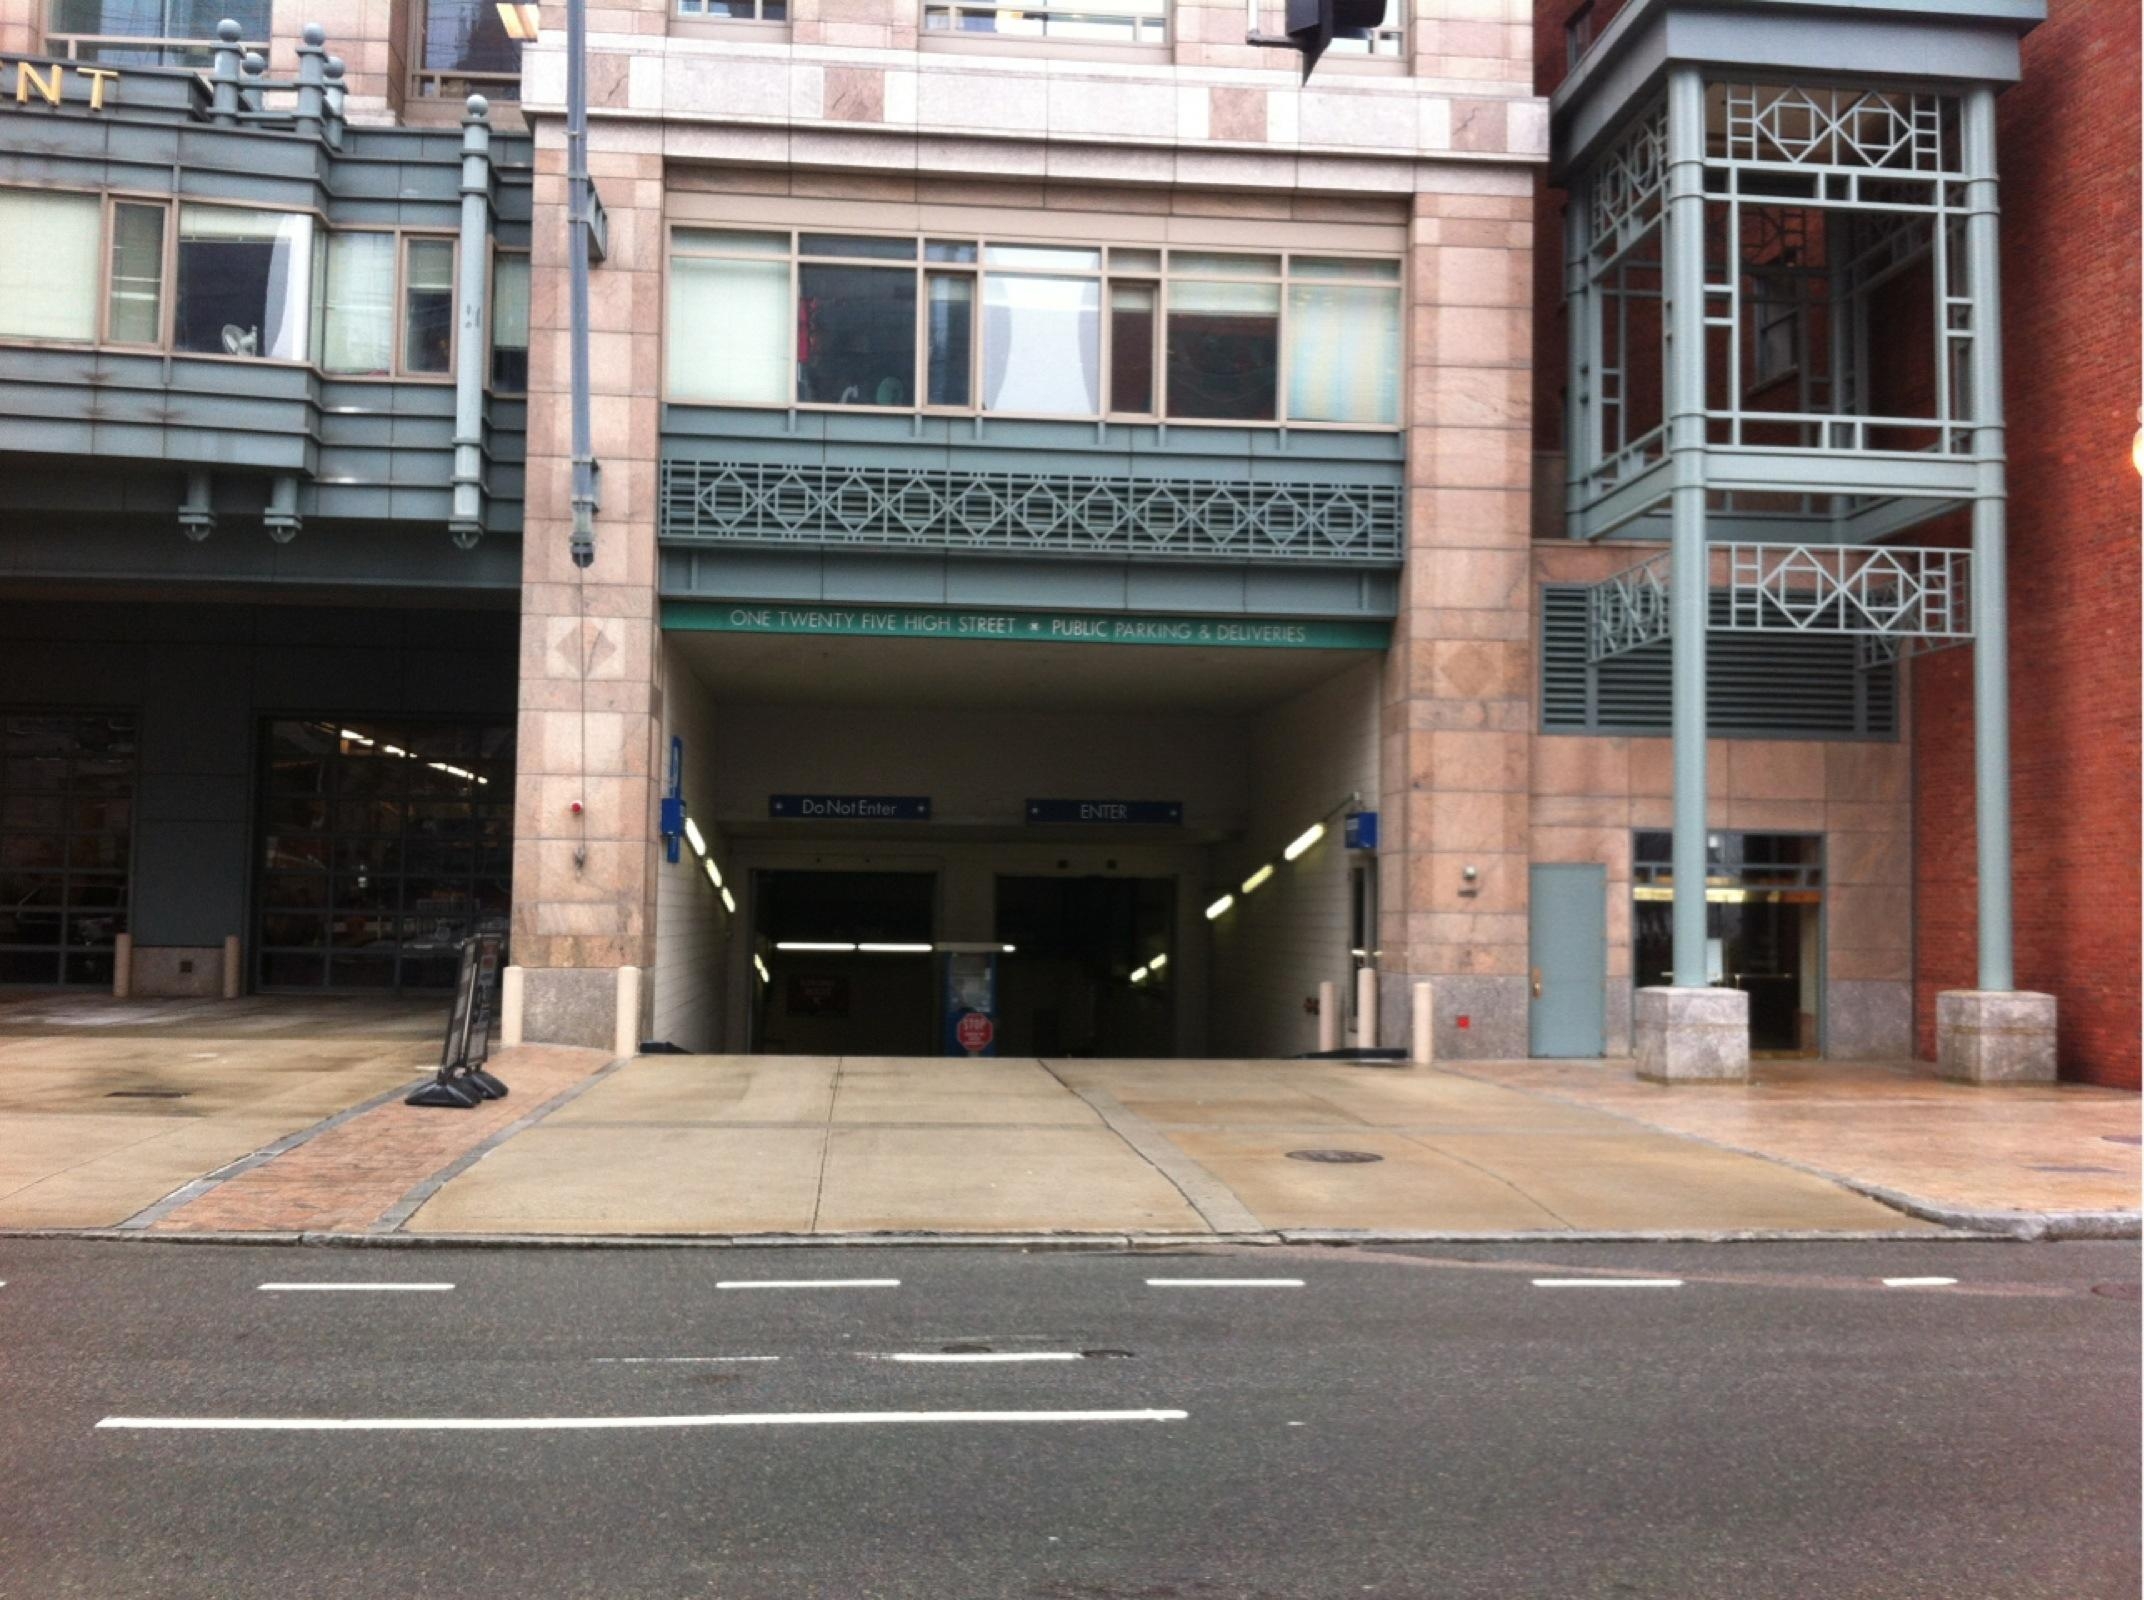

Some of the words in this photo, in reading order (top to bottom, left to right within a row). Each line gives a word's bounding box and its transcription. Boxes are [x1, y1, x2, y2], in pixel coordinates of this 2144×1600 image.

[0, 62, 118, 110] NT
[730, 609, 770, 626] ONE
[778, 611, 852, 629] TWENTY
[861, 612, 896, 630] FIVE
[904, 614, 950, 632] HIGH
[958, 616, 1016, 633] STREET
[1052, 619, 1107, 637] PUBLIC
[1115, 622, 1191, 640] PARKING
[1200, 625, 1210, 640] &
[1217, 624, 1306, 642] DELIVERIES
[802, 799, 824, 814] Do
[827, 800, 855, 814] Not
[859, 800, 897, 816] Enter
[1080, 804, 1128, 819] ENTER
